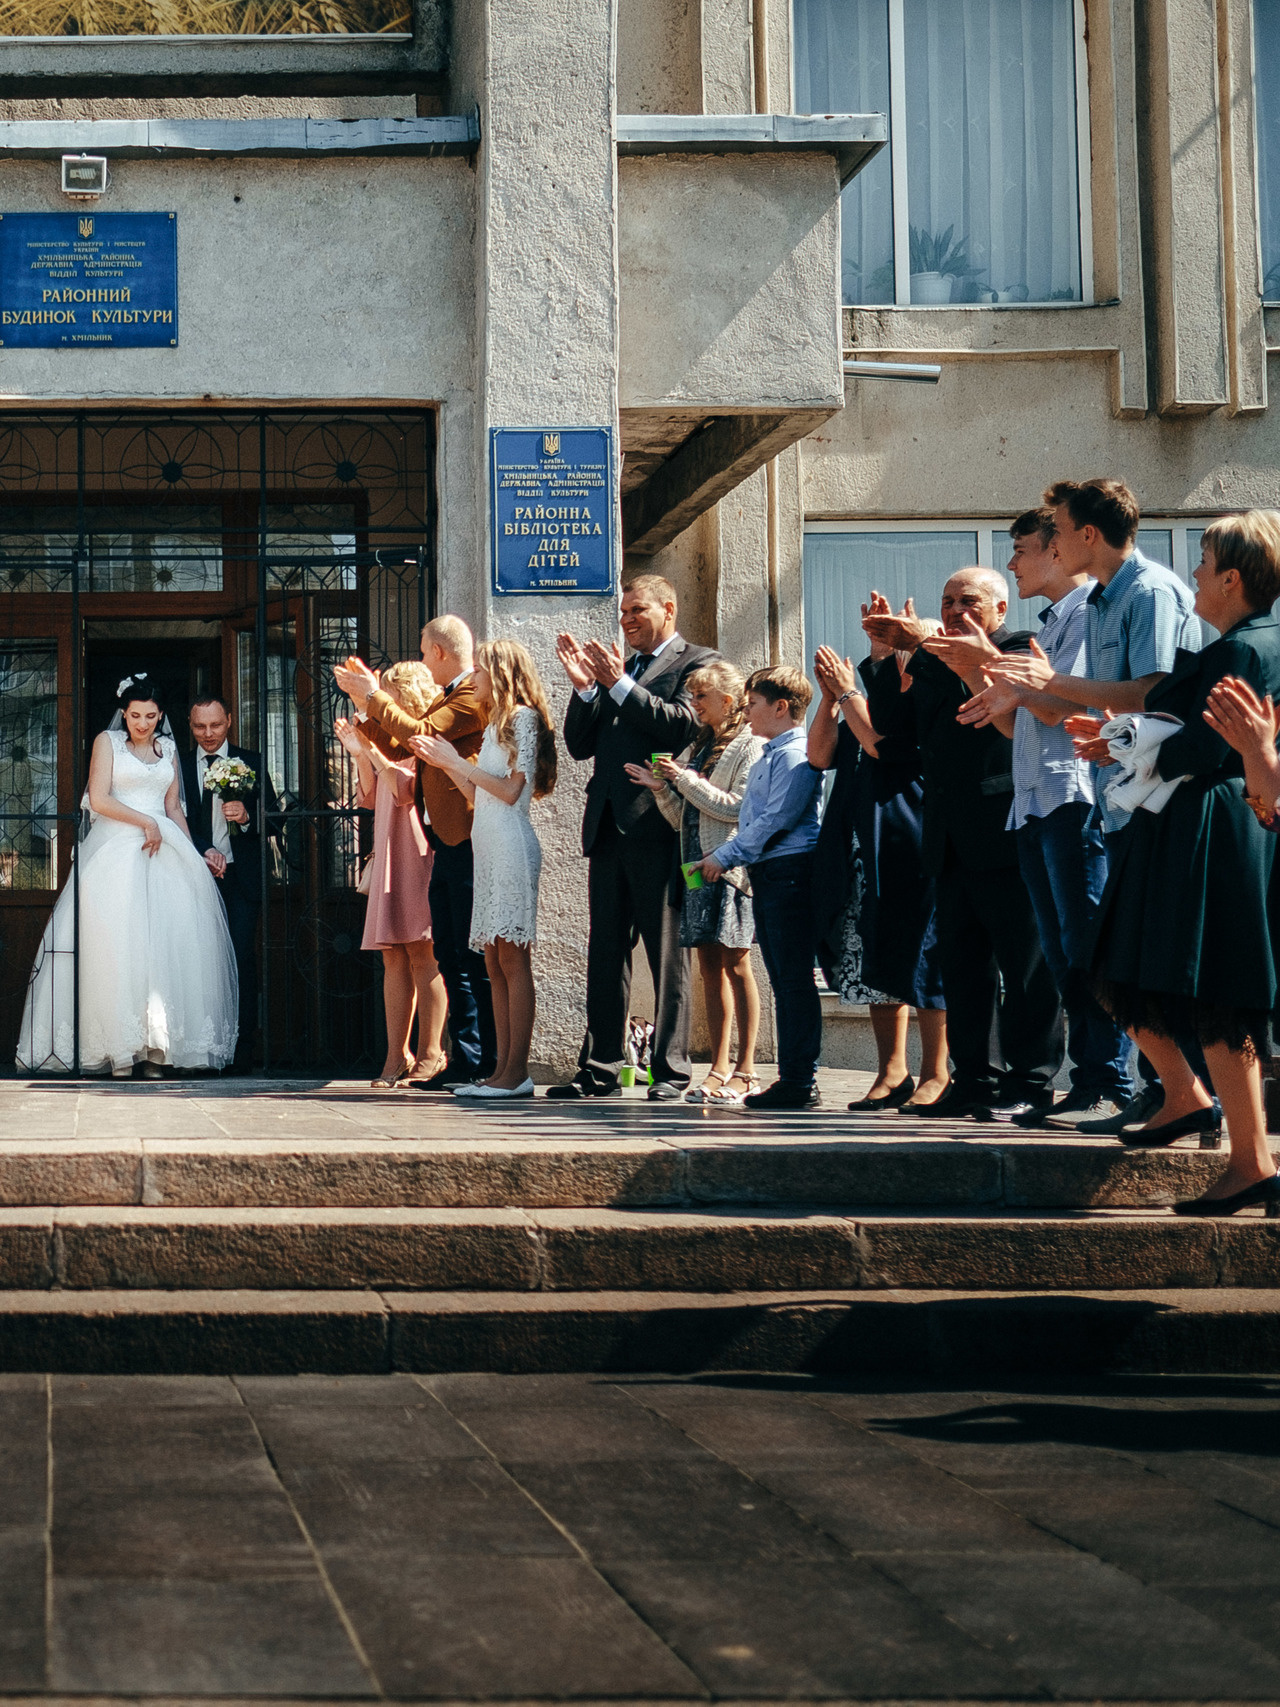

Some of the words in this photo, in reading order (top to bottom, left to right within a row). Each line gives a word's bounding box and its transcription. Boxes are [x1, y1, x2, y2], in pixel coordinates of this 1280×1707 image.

[42, 287, 131, 303] РАЙОННИЙ
[2, 310, 76, 325] БУДИНОК
[92, 310, 172, 324] КУЛЬТУРИ
[515, 504, 591, 519] РАЙОННА
[504, 523, 602, 535] БІБЛІОТЕКА
[538, 539, 570, 552] ДЛЯ
[528, 552, 580, 568] ДІТЕЙ
